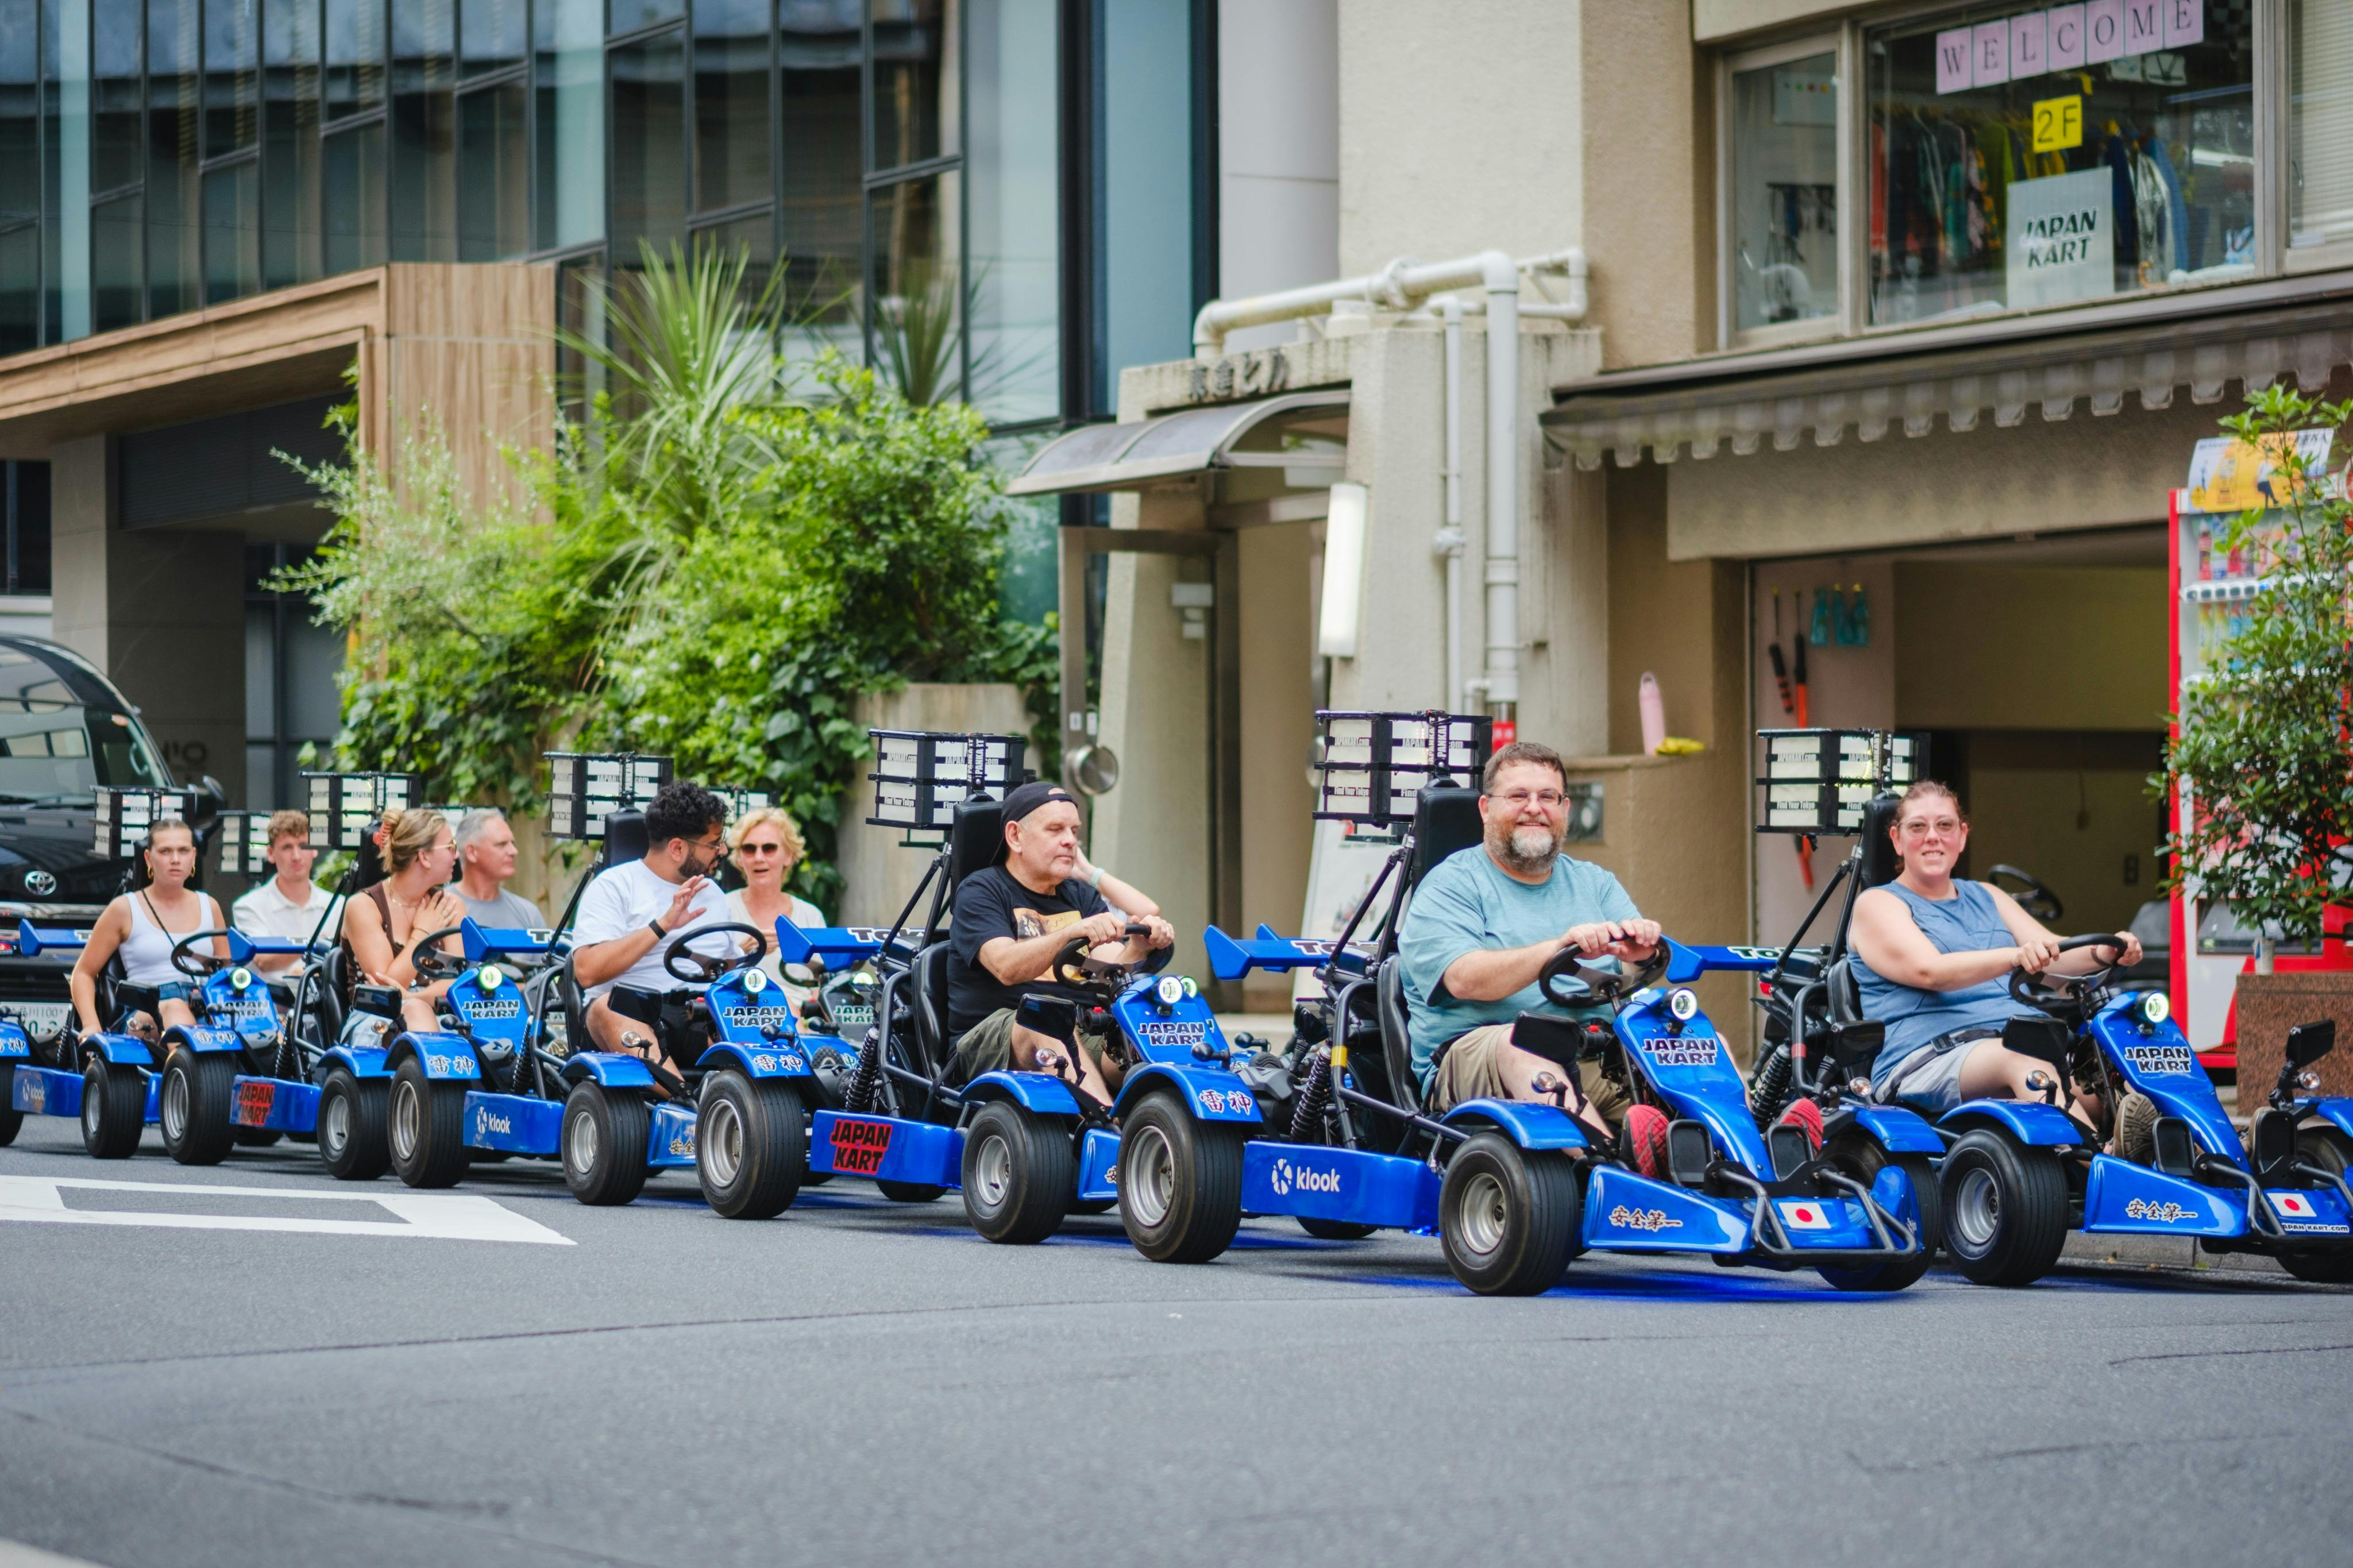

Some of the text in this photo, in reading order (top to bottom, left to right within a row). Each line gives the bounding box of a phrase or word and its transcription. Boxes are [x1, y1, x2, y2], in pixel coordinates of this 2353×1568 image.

[1944, 0, 2192, 75] WELCOME
[2037, 104, 2078, 143] 2F
[2022, 210, 2097, 239] JAPAN
[2027, 236, 2091, 269] KART
[1334, 737, 1370, 747] JAPANKART.com
[1777, 754, 1816, 763] JAPANKART.com
[464, 999, 519, 1010] JAPAN
[723, 1006, 786, 1017] JAPAN
[834, 1006, 874, 1015] JAPA
[472, 1010, 519, 1019] KART
[733, 1016, 785, 1027] KART
[1139, 1022, 1204, 1034] JAPAN
[1150, 1034, 1204, 1045] KART
[1642, 1039, 1717, 1052] JAPAN
[1656, 1052, 1717, 1065] KART
[2125, 1046, 2192, 1060] JAPAN
[430, 1055, 475, 1075] 雷神
[754, 1055, 802, 1072] 雷神
[2138, 1060, 2191, 1073] KART
[239, 1084, 274, 1103] JAPAN
[1199, 1090, 1252, 1115] 雷神
[241, 1104, 269, 1123] KART
[489, 1113, 511, 1134] klook
[831, 1121, 892, 1147] JAPAN
[834, 1146, 883, 1172] KART
[1297, 1166, 1340, 1192] klook
[1609, 1206, 1683, 1232] 安全第一
[2126, 1198, 2198, 1222] 安全第一
